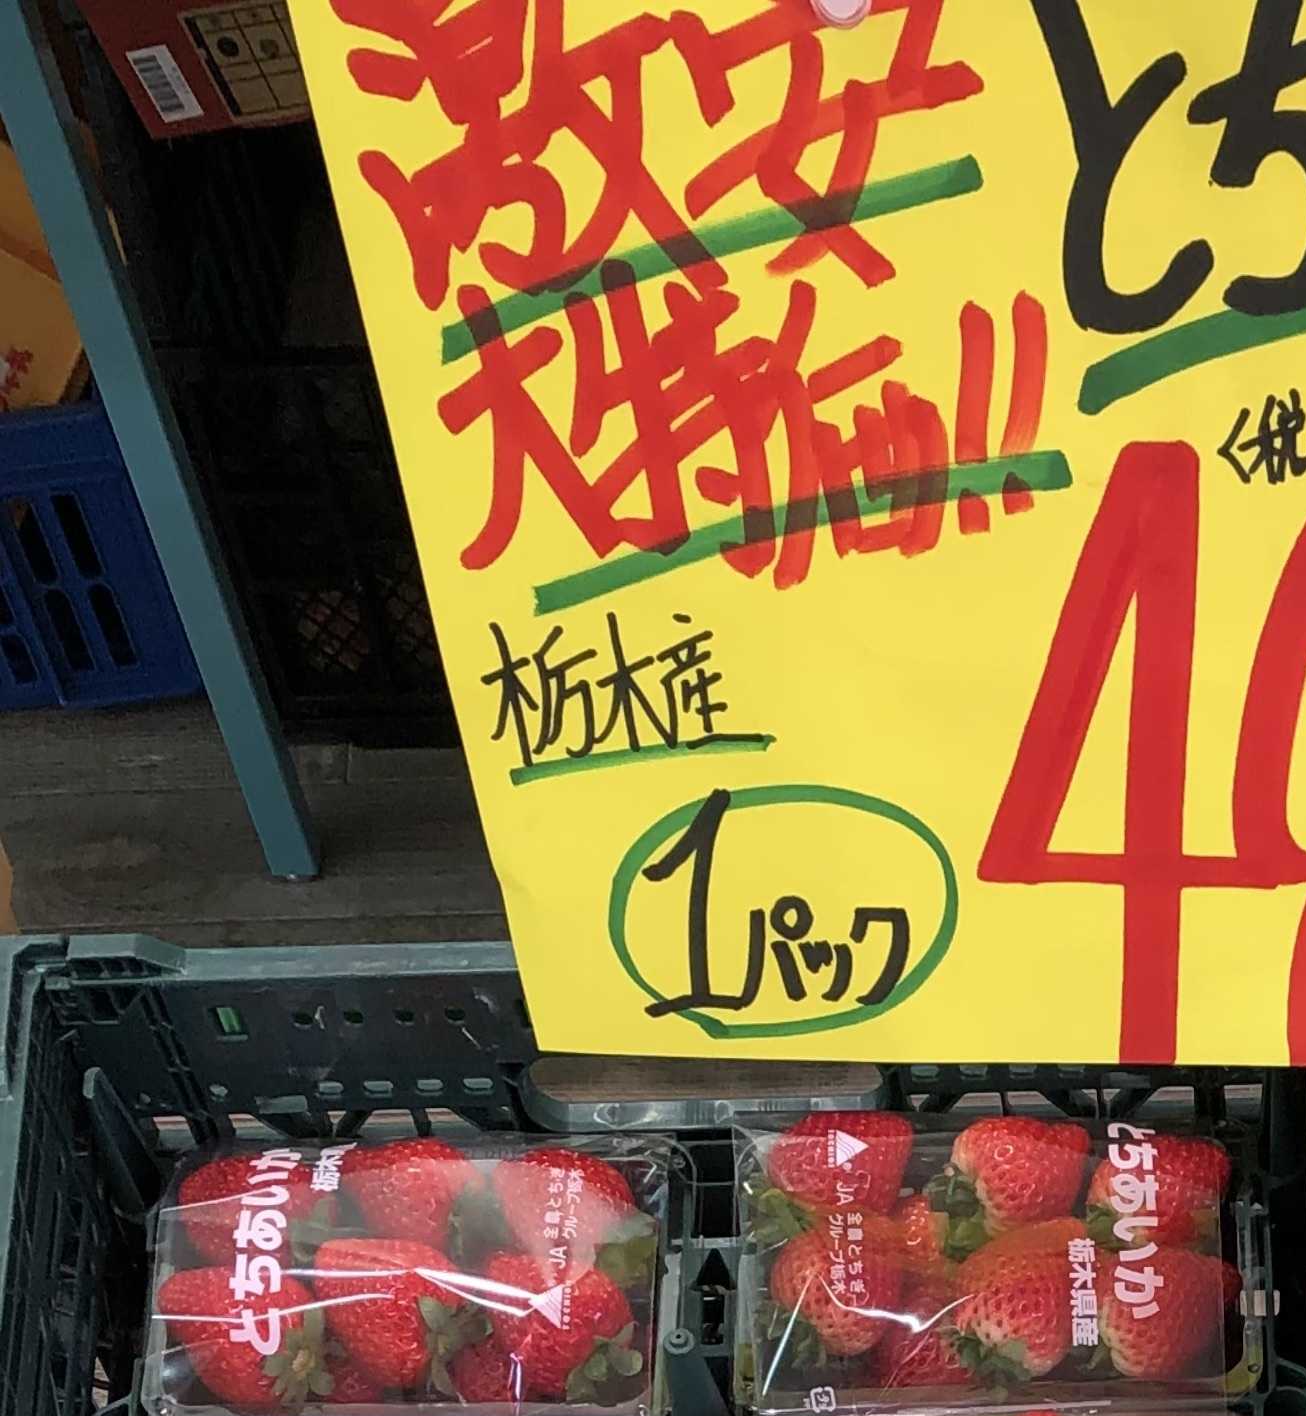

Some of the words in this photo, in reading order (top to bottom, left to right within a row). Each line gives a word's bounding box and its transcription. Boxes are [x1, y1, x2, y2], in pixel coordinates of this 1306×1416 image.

[481, 612, 764, 767] 栃木産
[642, 788, 911, 1019] 1パック
[229, 1147, 303, 1356] とちあいか
[550, 1245, 567, 1269] JA
[836, 1181, 852, 1206] JA
[1107, 1122, 1167, 1319] とちあいか
[1067, 1238, 1099, 1347] 栃木県産
